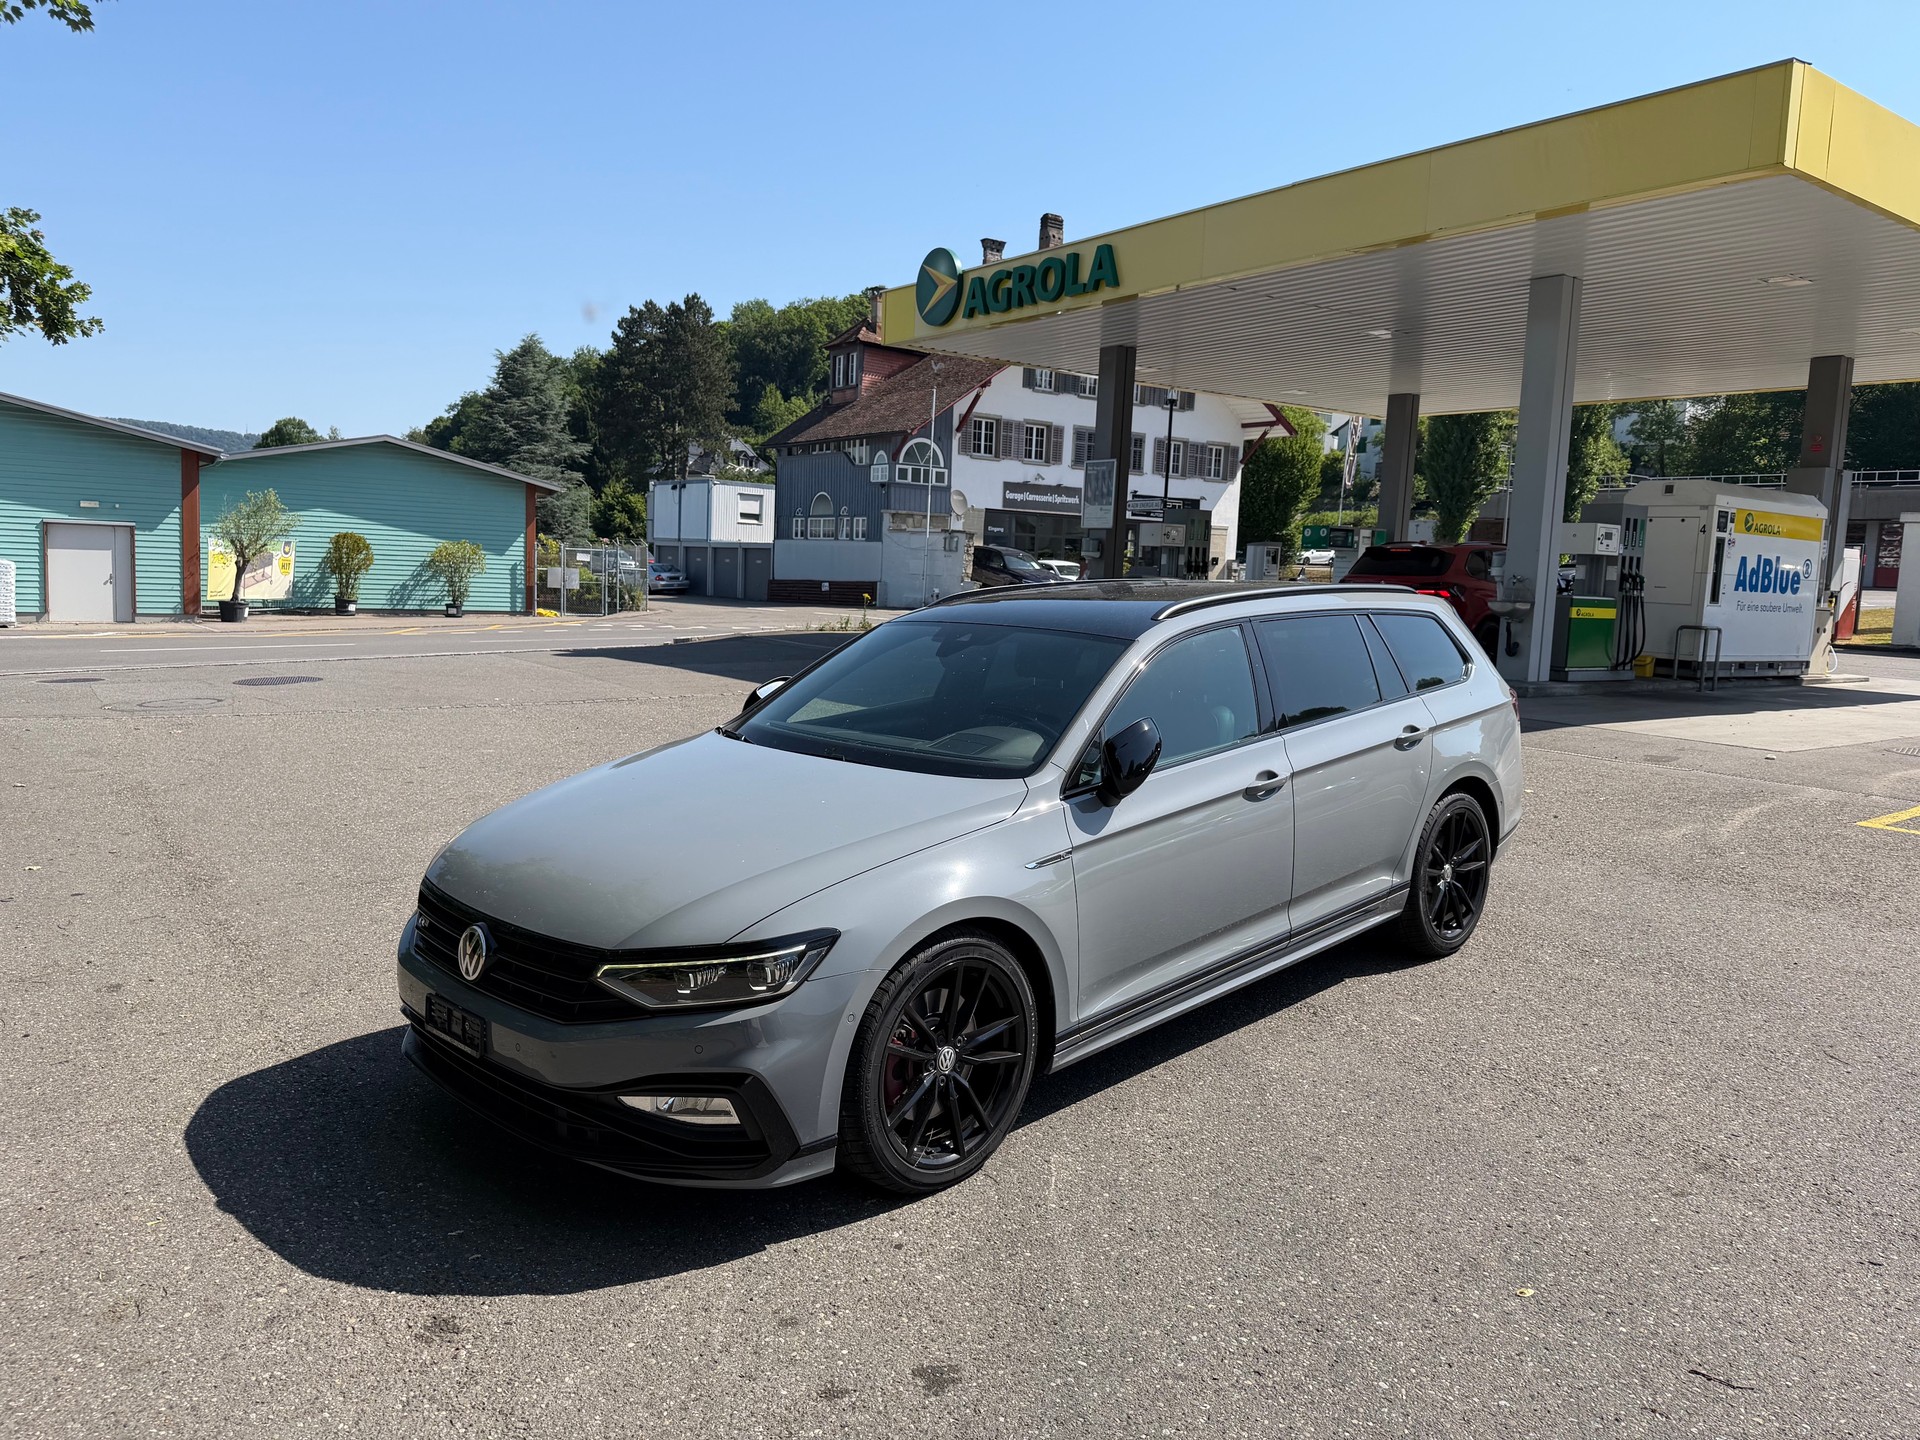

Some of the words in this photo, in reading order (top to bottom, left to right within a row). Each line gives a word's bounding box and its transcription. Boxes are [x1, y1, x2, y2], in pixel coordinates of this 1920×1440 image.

[962, 244, 1120, 319] AGROLA
[1005, 490, 1024, 502] Garage
[1699, 524, 1706, 534] 4
[1753, 523, 1781, 536] AGROLA
[1736, 600, 1746, 612] Für
[1747, 601, 1759, 612] eine
[1760, 601, 1781, 613] saubere
